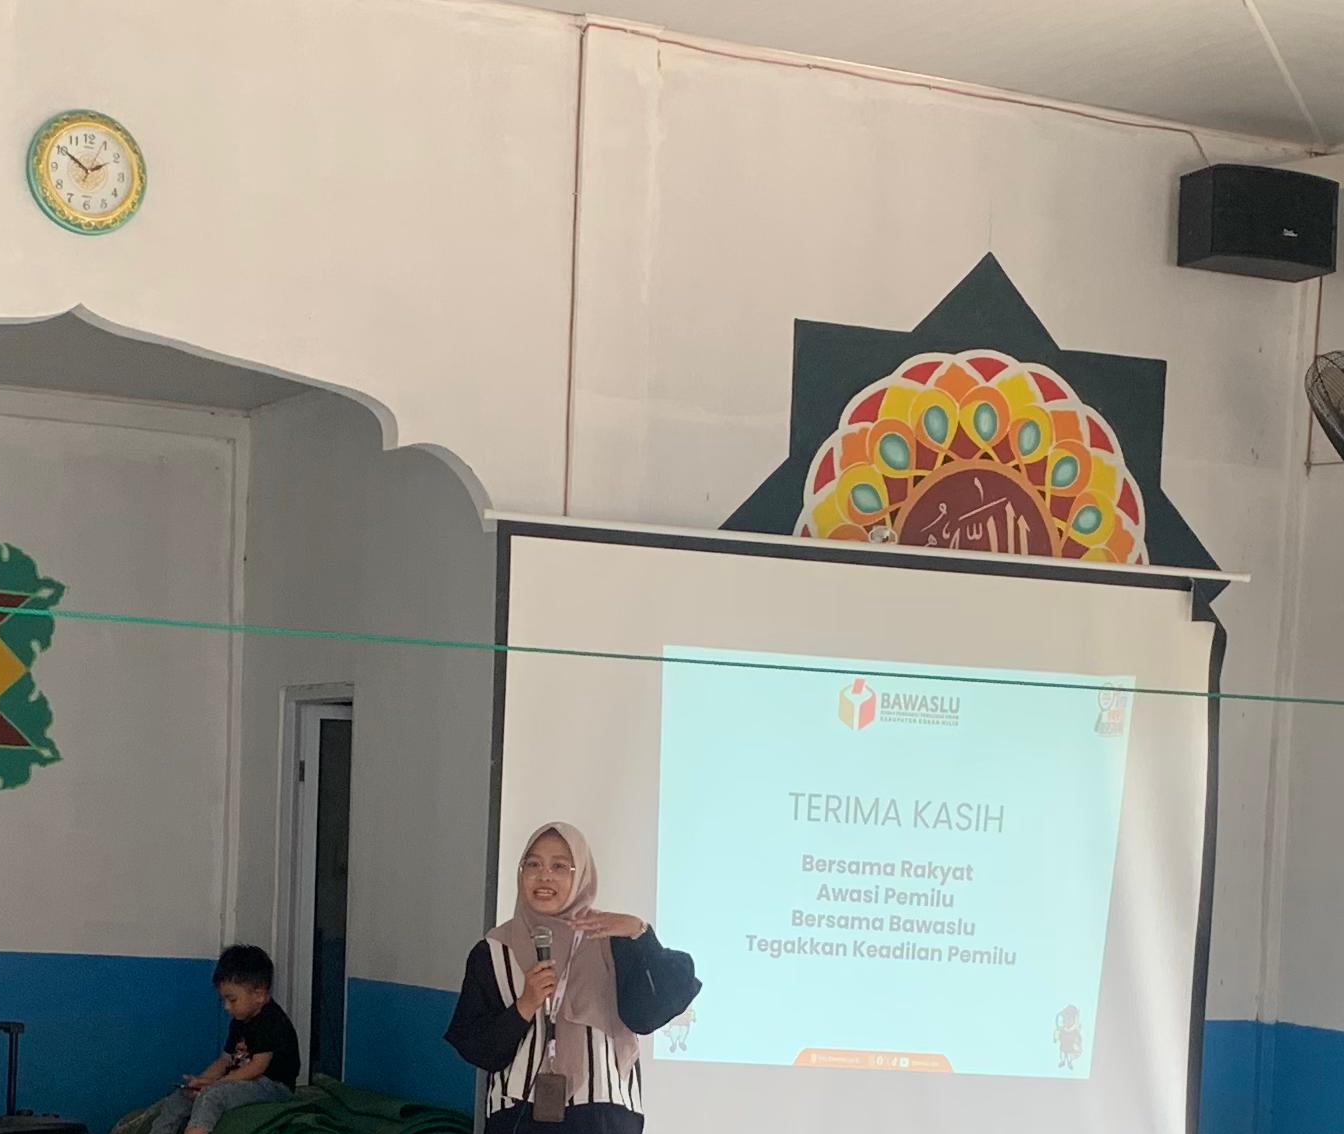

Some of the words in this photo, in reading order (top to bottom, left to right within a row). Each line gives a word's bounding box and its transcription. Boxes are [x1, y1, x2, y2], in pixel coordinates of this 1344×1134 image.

[69, 135, 79, 146] 11
[83, 133, 96, 145] 12
[113, 152, 120, 163] 2
[56, 179, 64, 189] 8
[67, 193, 74, 203] 7
[112, 187, 118, 198] 4
[83, 200, 91, 211] 6
[880, 692, 961, 714] BAWASLU
[788, 792, 902, 827] TERIMA
[913, 800, 1005, 833] KASIH
[801, 854, 896, 877] Bersama
[900, 861, 974, 886] Rakyat
[816, 884, 880, 904] Awasi
[883, 888, 955, 908] Pemilu
[791, 910, 884, 932] Bersama
[888, 915, 976, 937] Bawaslu
[745, 934, 848, 959] Tegakkan
[852, 940, 943, 962] Keadilan
[947, 945, 1018, 966] Pemilu
